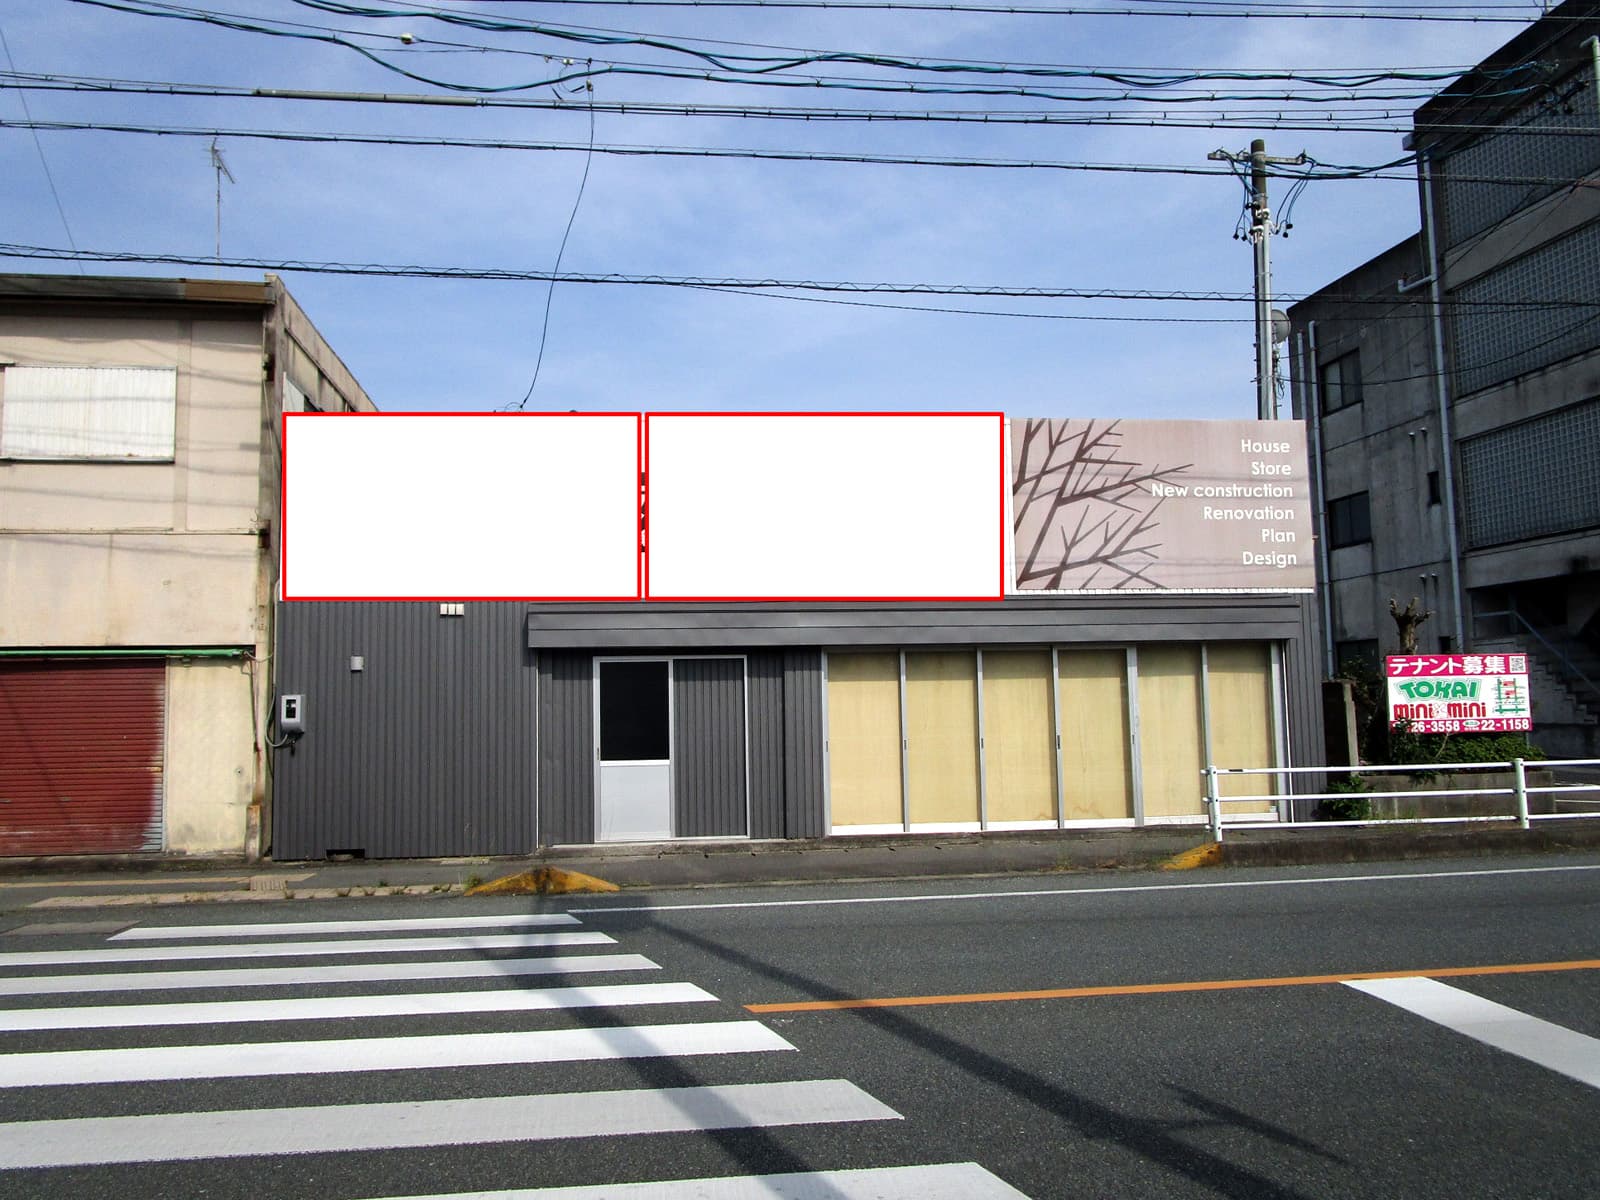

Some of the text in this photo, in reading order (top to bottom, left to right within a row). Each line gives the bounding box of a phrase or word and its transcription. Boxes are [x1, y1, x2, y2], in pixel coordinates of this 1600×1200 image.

[1241, 439, 1290, 453] House
[1251, 461, 1292, 475] Store
[1151, 483, 1293, 497] New construction
[1203, 506, 1294, 520] Renovation
[1261, 528, 1296, 542] Plan
[1242, 551, 1297, 568] Design
[1389, 656, 1506, 675] テナント募集
[1399, 681, 1477, 698] TOKAI
[1481, 719, 1529, 731] 22-1158
